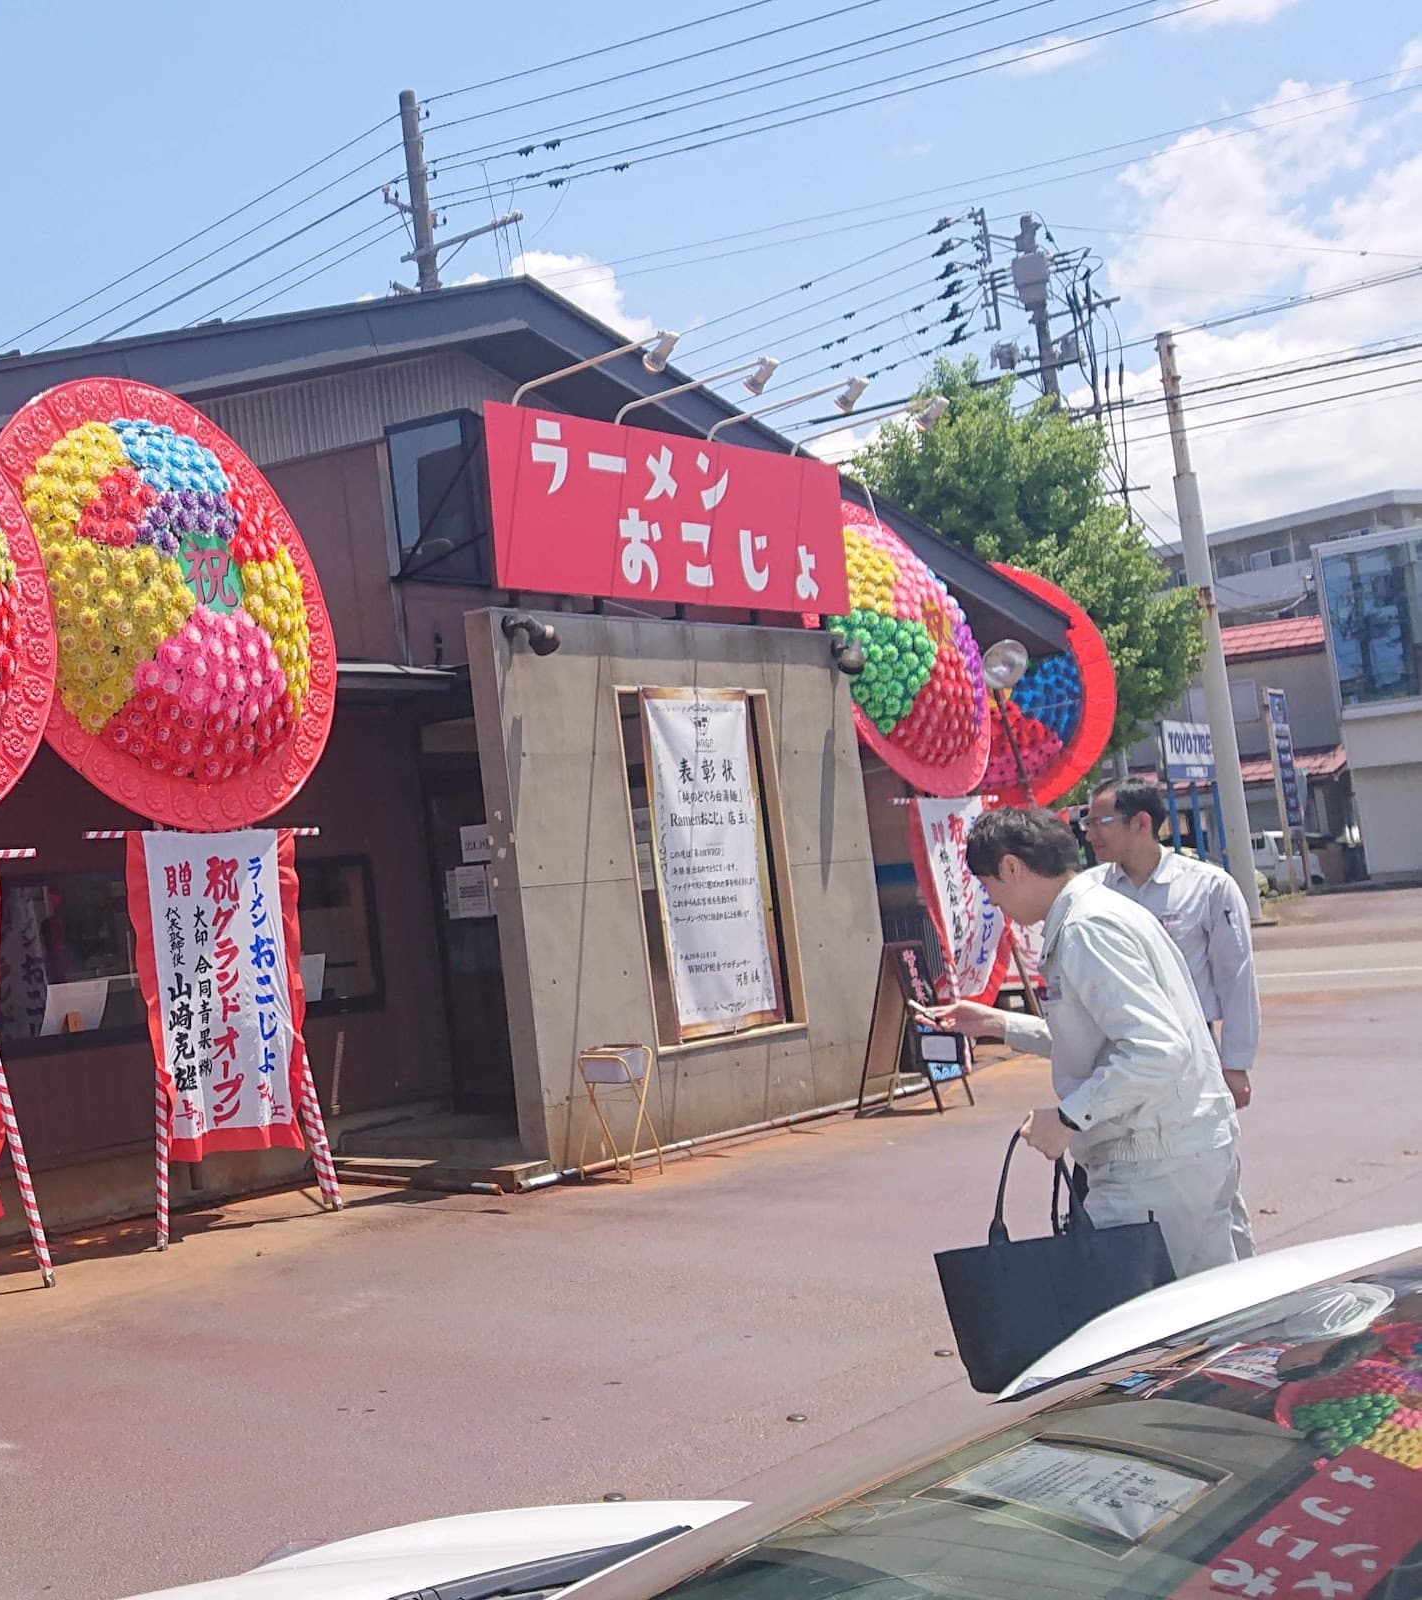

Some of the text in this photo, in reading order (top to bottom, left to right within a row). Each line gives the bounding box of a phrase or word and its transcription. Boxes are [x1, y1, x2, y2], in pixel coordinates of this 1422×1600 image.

[530, 417, 729, 511] ラーメン
[183, 541, 238, 607] 祝
[618, 507, 820, 600] おこじょ
[678, 756, 736, 784] 表彰状
[1168, 732, 1193, 754] TOYO
[164, 860, 192, 899] 贈
[202, 855, 245, 1127] 祝グランドオープン
